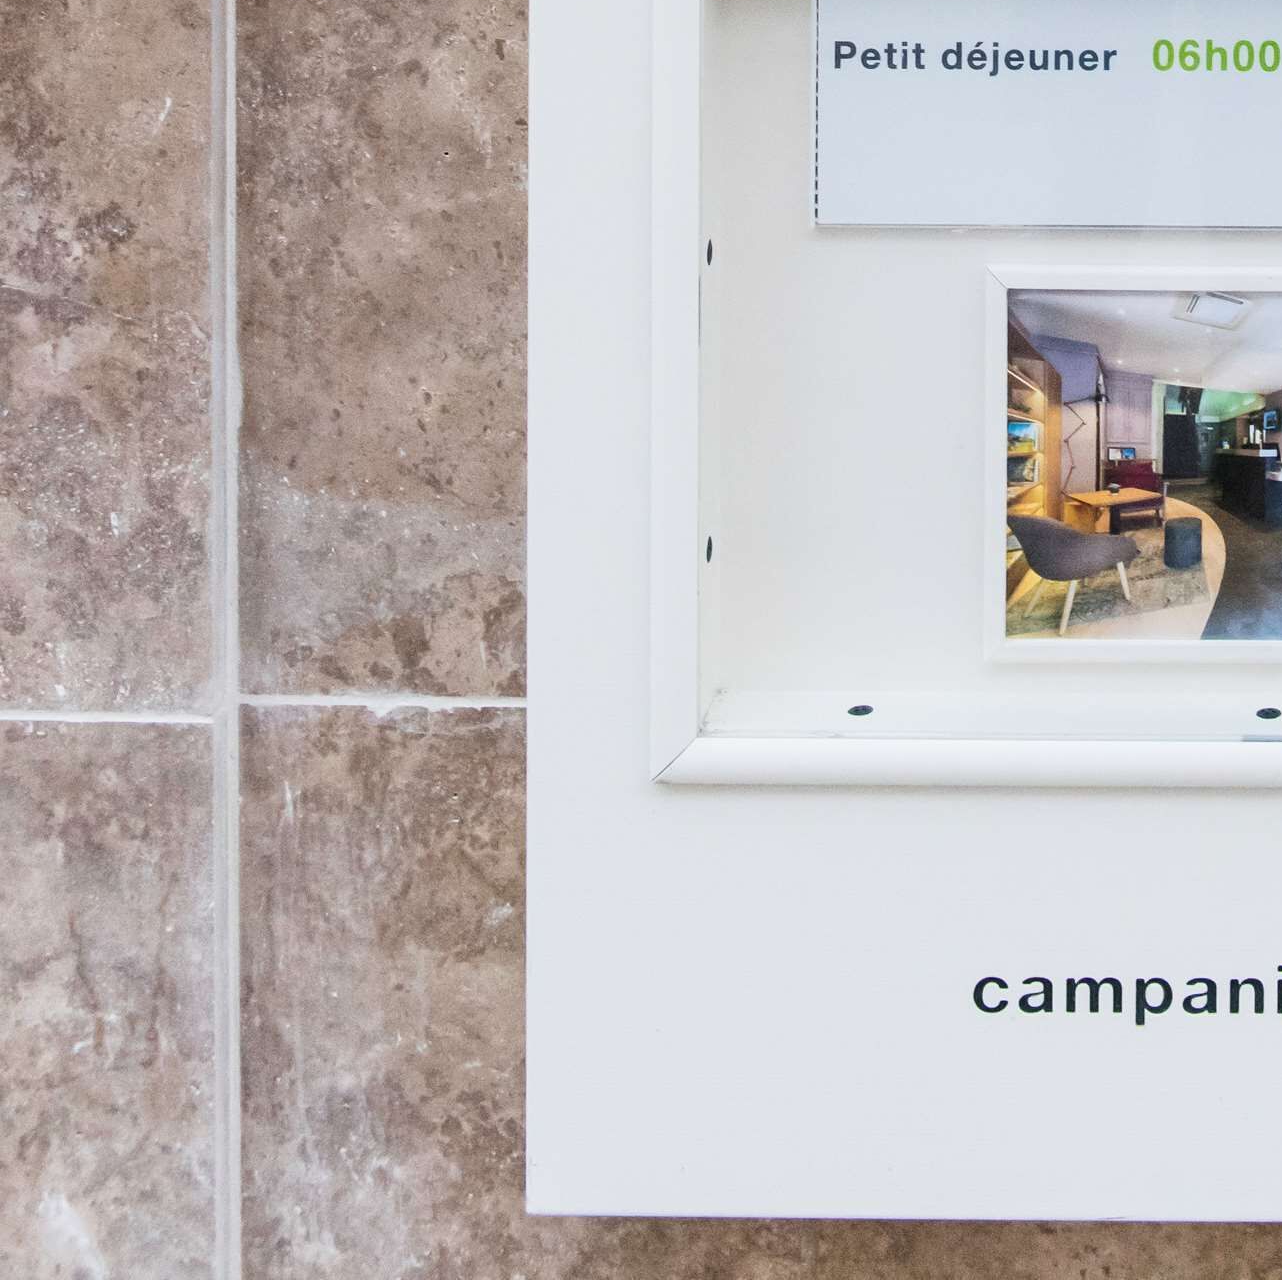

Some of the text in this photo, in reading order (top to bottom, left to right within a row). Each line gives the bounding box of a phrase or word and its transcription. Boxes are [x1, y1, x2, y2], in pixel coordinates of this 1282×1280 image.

[836, 42, 926, 70] Petit
[943, 43, 1118, 77] déjeuner
[1154, 40, 1281, 73] 06h00
